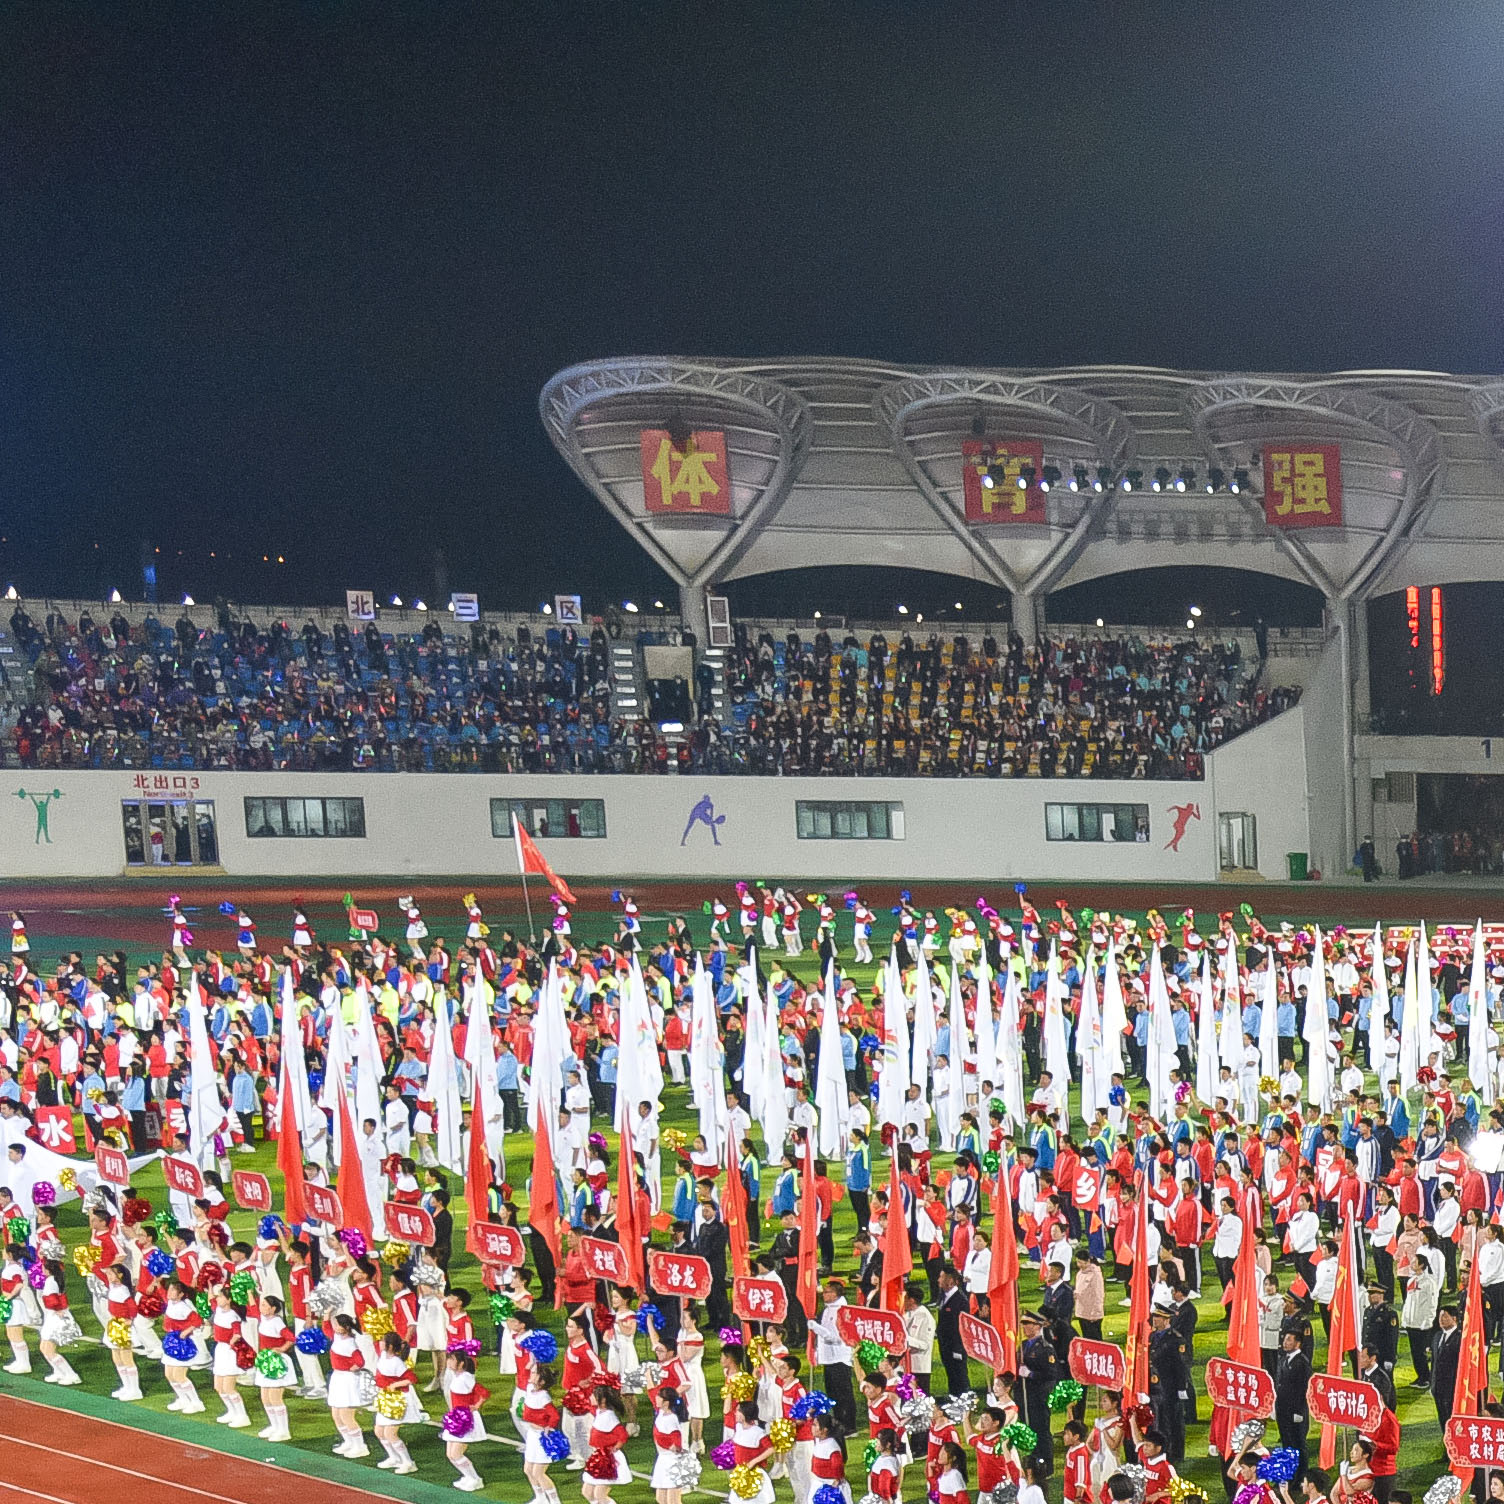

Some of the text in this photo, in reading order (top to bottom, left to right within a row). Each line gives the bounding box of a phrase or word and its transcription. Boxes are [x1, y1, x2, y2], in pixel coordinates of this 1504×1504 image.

[651, 437, 719, 507] 体
[1273, 453, 1332, 517] 强
[350, 595, 372, 616] 北
[559, 601, 578, 620] 区
[1480, 739, 1492, 759] 1
[38, 1114, 72, 1147] 水
[1075, 1171, 1097, 1204] 乡
[667, 1262, 697, 1289] 洛龙
[747, 1288, 775, 1313] 伊滨
[854, 1317, 895, 1345] 市城管局
[1083, 1351, 1116, 1380] 市民政局
[1225, 1367, 1260, 1390] 市市场
[1226, 1386, 1260, 1409] 监管局
[1327, 1388, 1368, 1420] 市审计局
